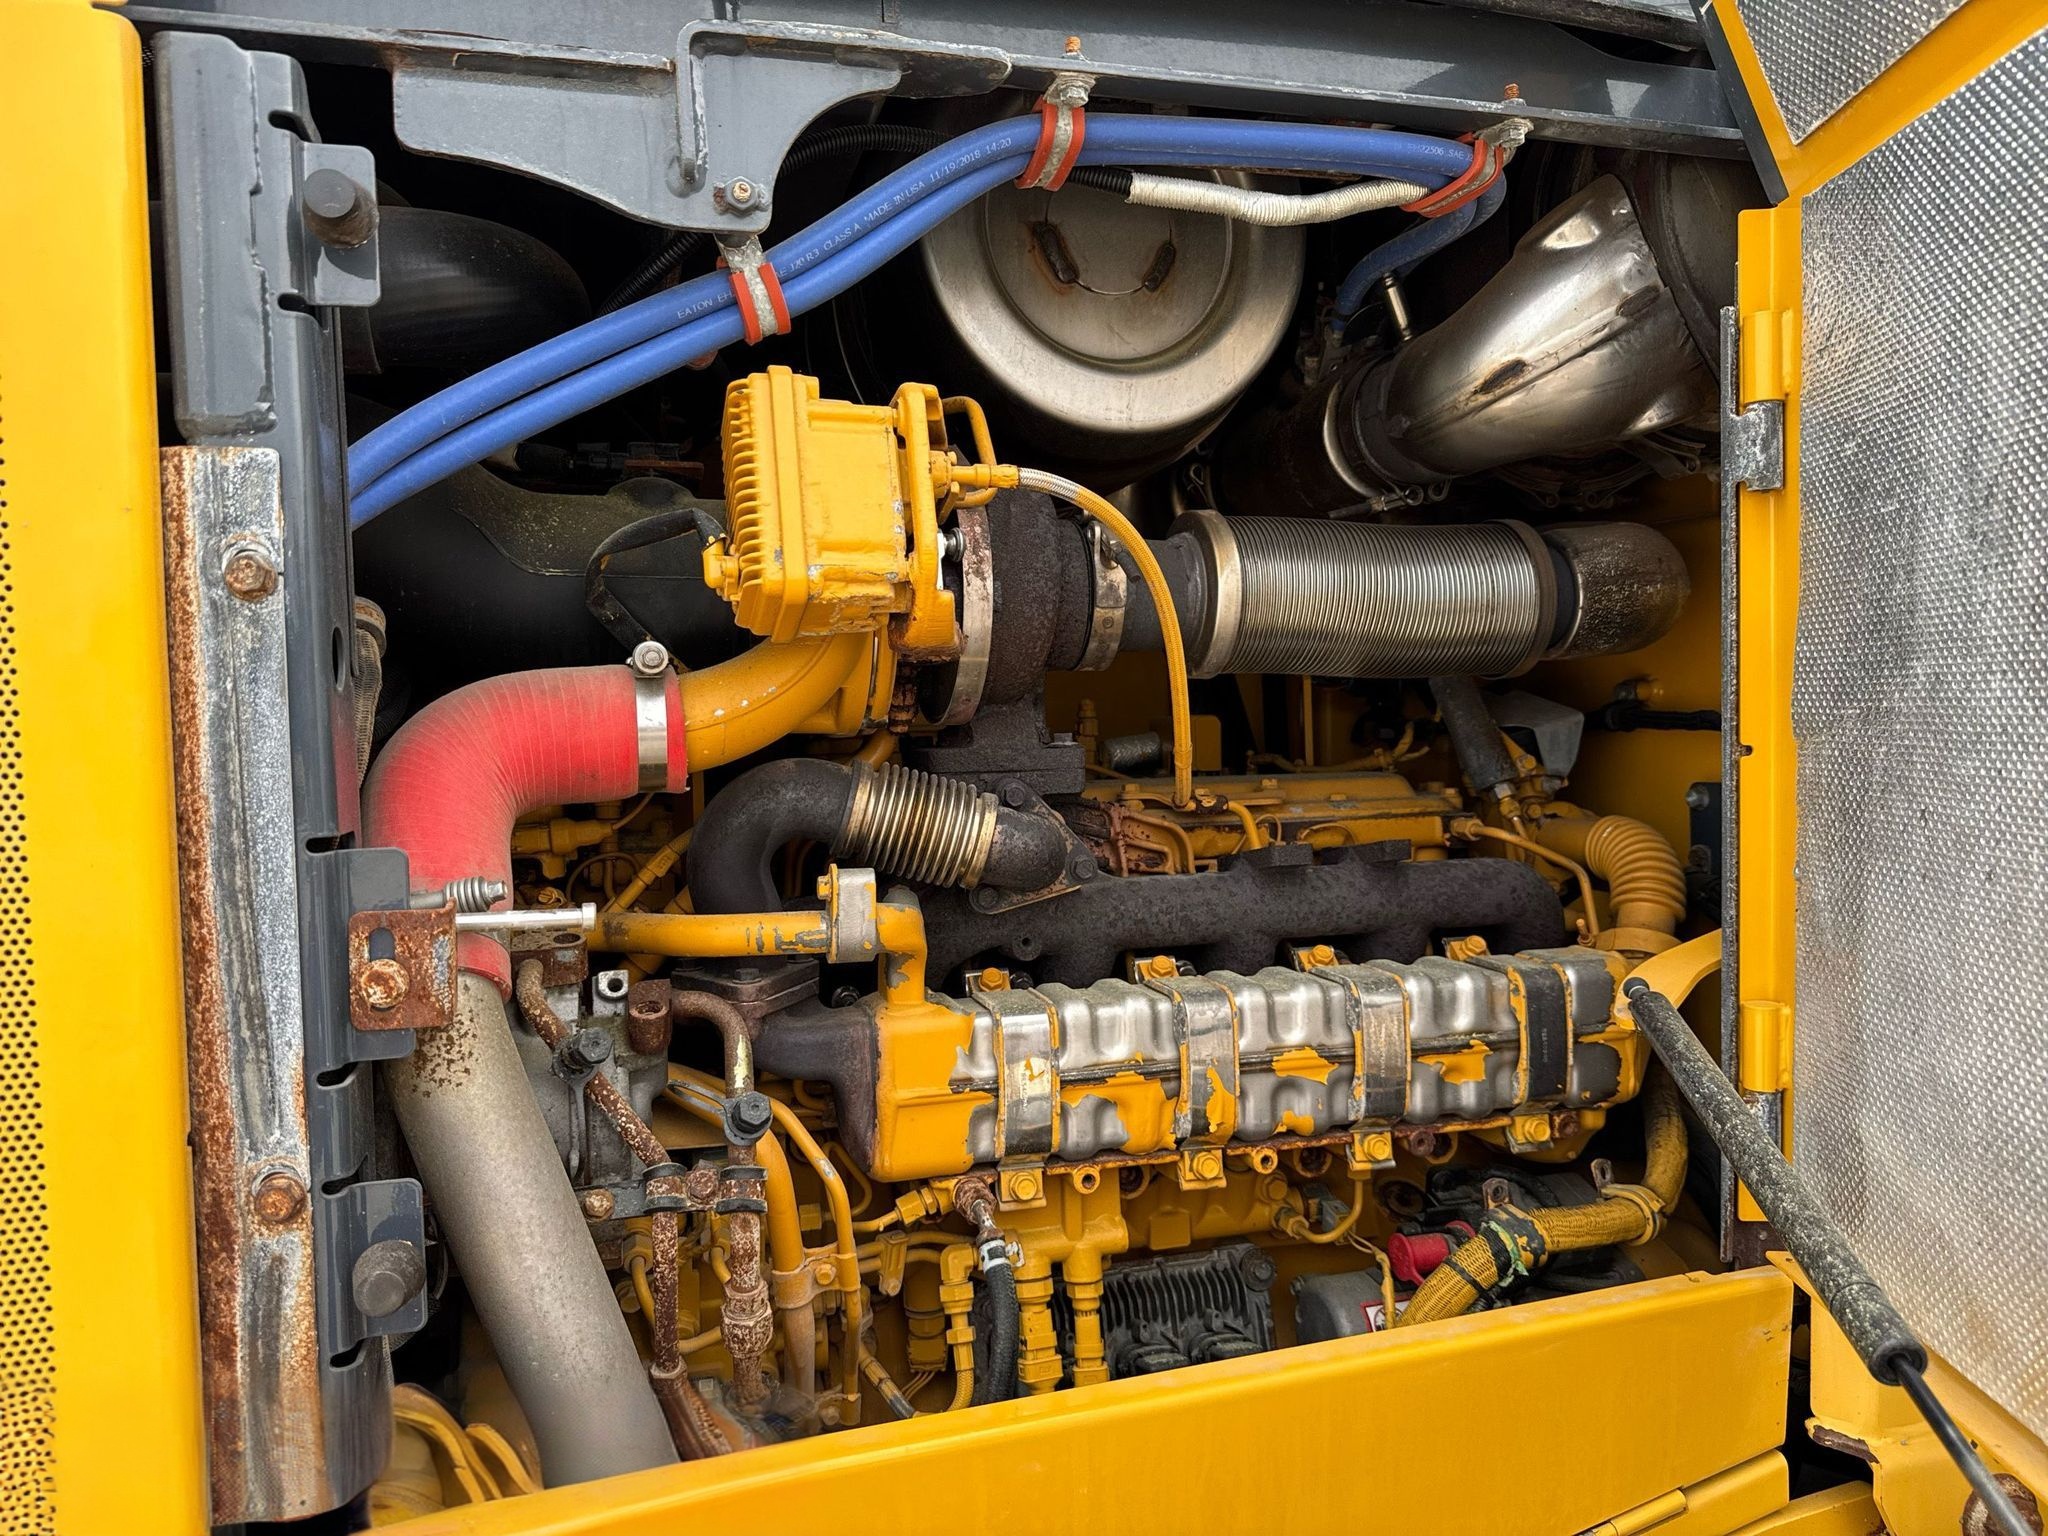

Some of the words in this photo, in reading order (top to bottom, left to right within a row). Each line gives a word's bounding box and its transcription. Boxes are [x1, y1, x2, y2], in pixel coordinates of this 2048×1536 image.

[1447, 149, 1465, 160] SAE
[677, 299, 713, 318] EATON
[823, 227, 852, 251] CLASS
[854, 223, 862, 233] A
[864, 202, 893, 222] MADE
[894, 192, 905, 206] IN
[905, 180, 925, 198] USA
[929, 149, 982, 183] 11/19/2018
[985, 137, 1012, 154] 14:20
